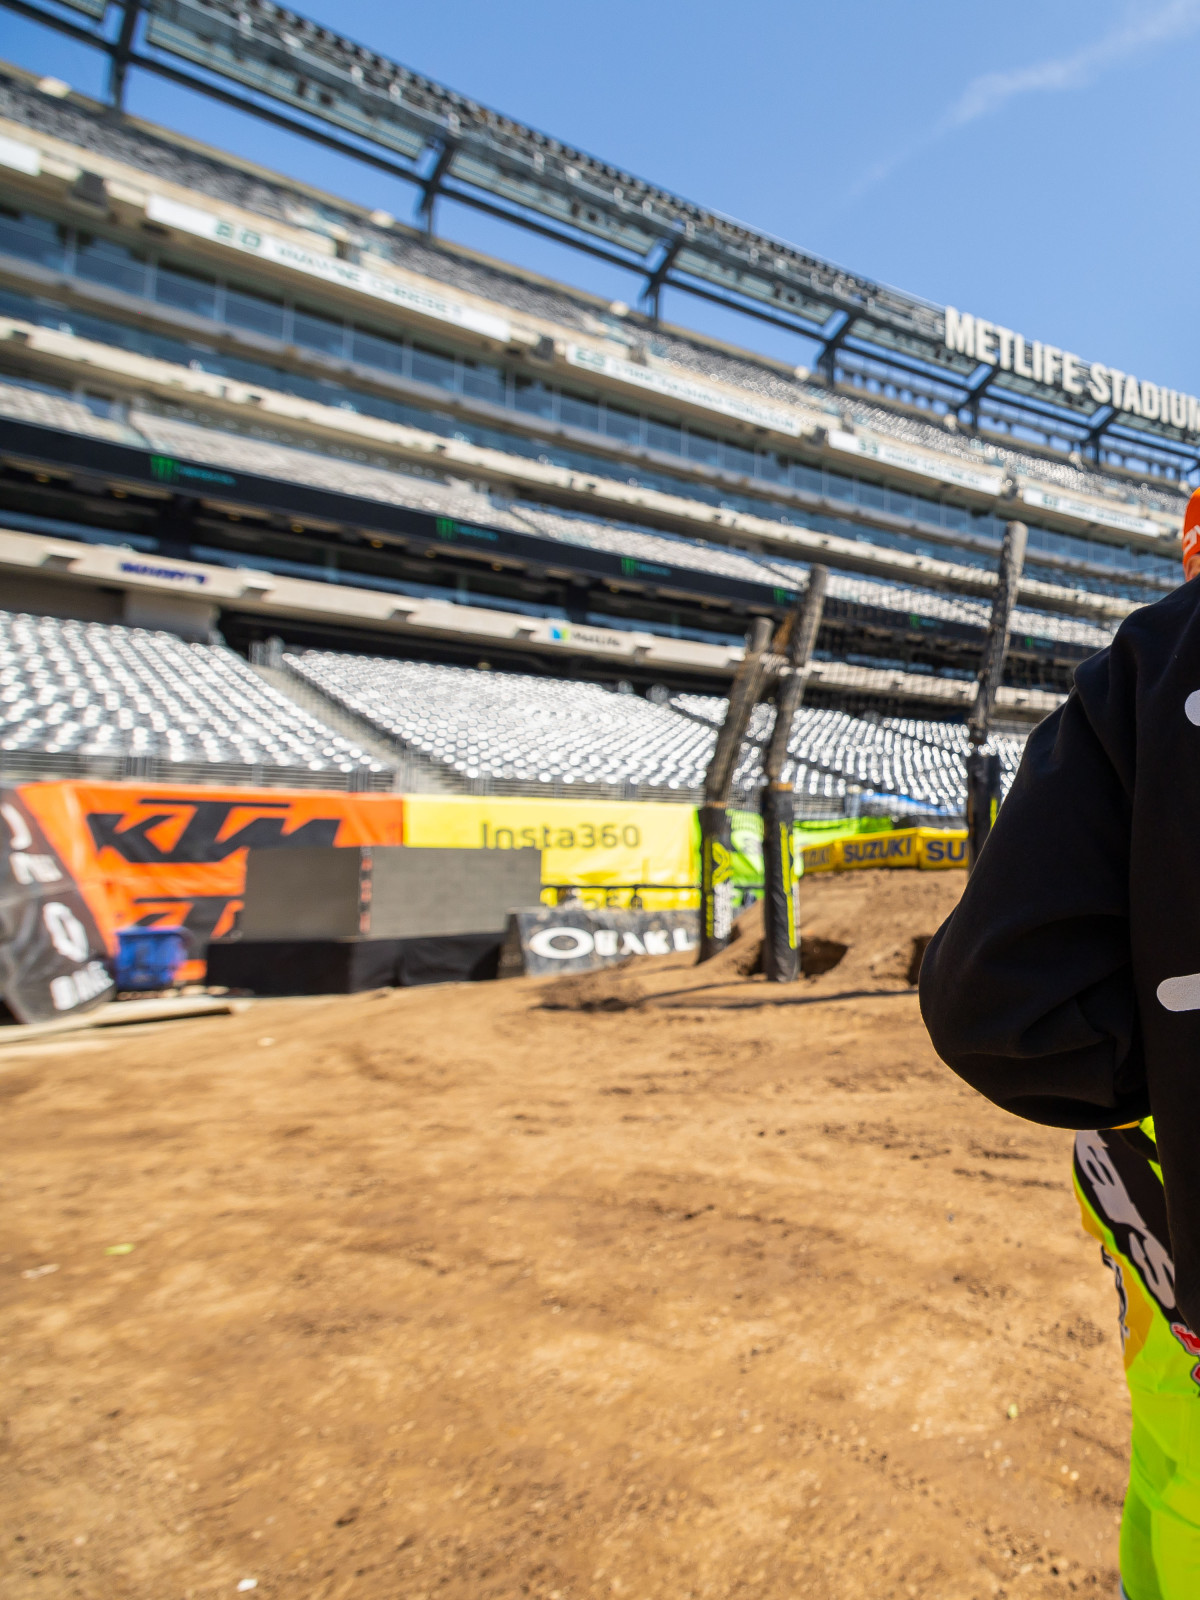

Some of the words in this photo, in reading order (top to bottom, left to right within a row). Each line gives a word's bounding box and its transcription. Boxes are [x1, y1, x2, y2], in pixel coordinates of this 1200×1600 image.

[944, 305, 1082, 396] METLIFE
[86, 798, 343, 864] KTM
[481, 822, 641, 850] Insta360
[842, 836, 912, 864] SUZUKI
